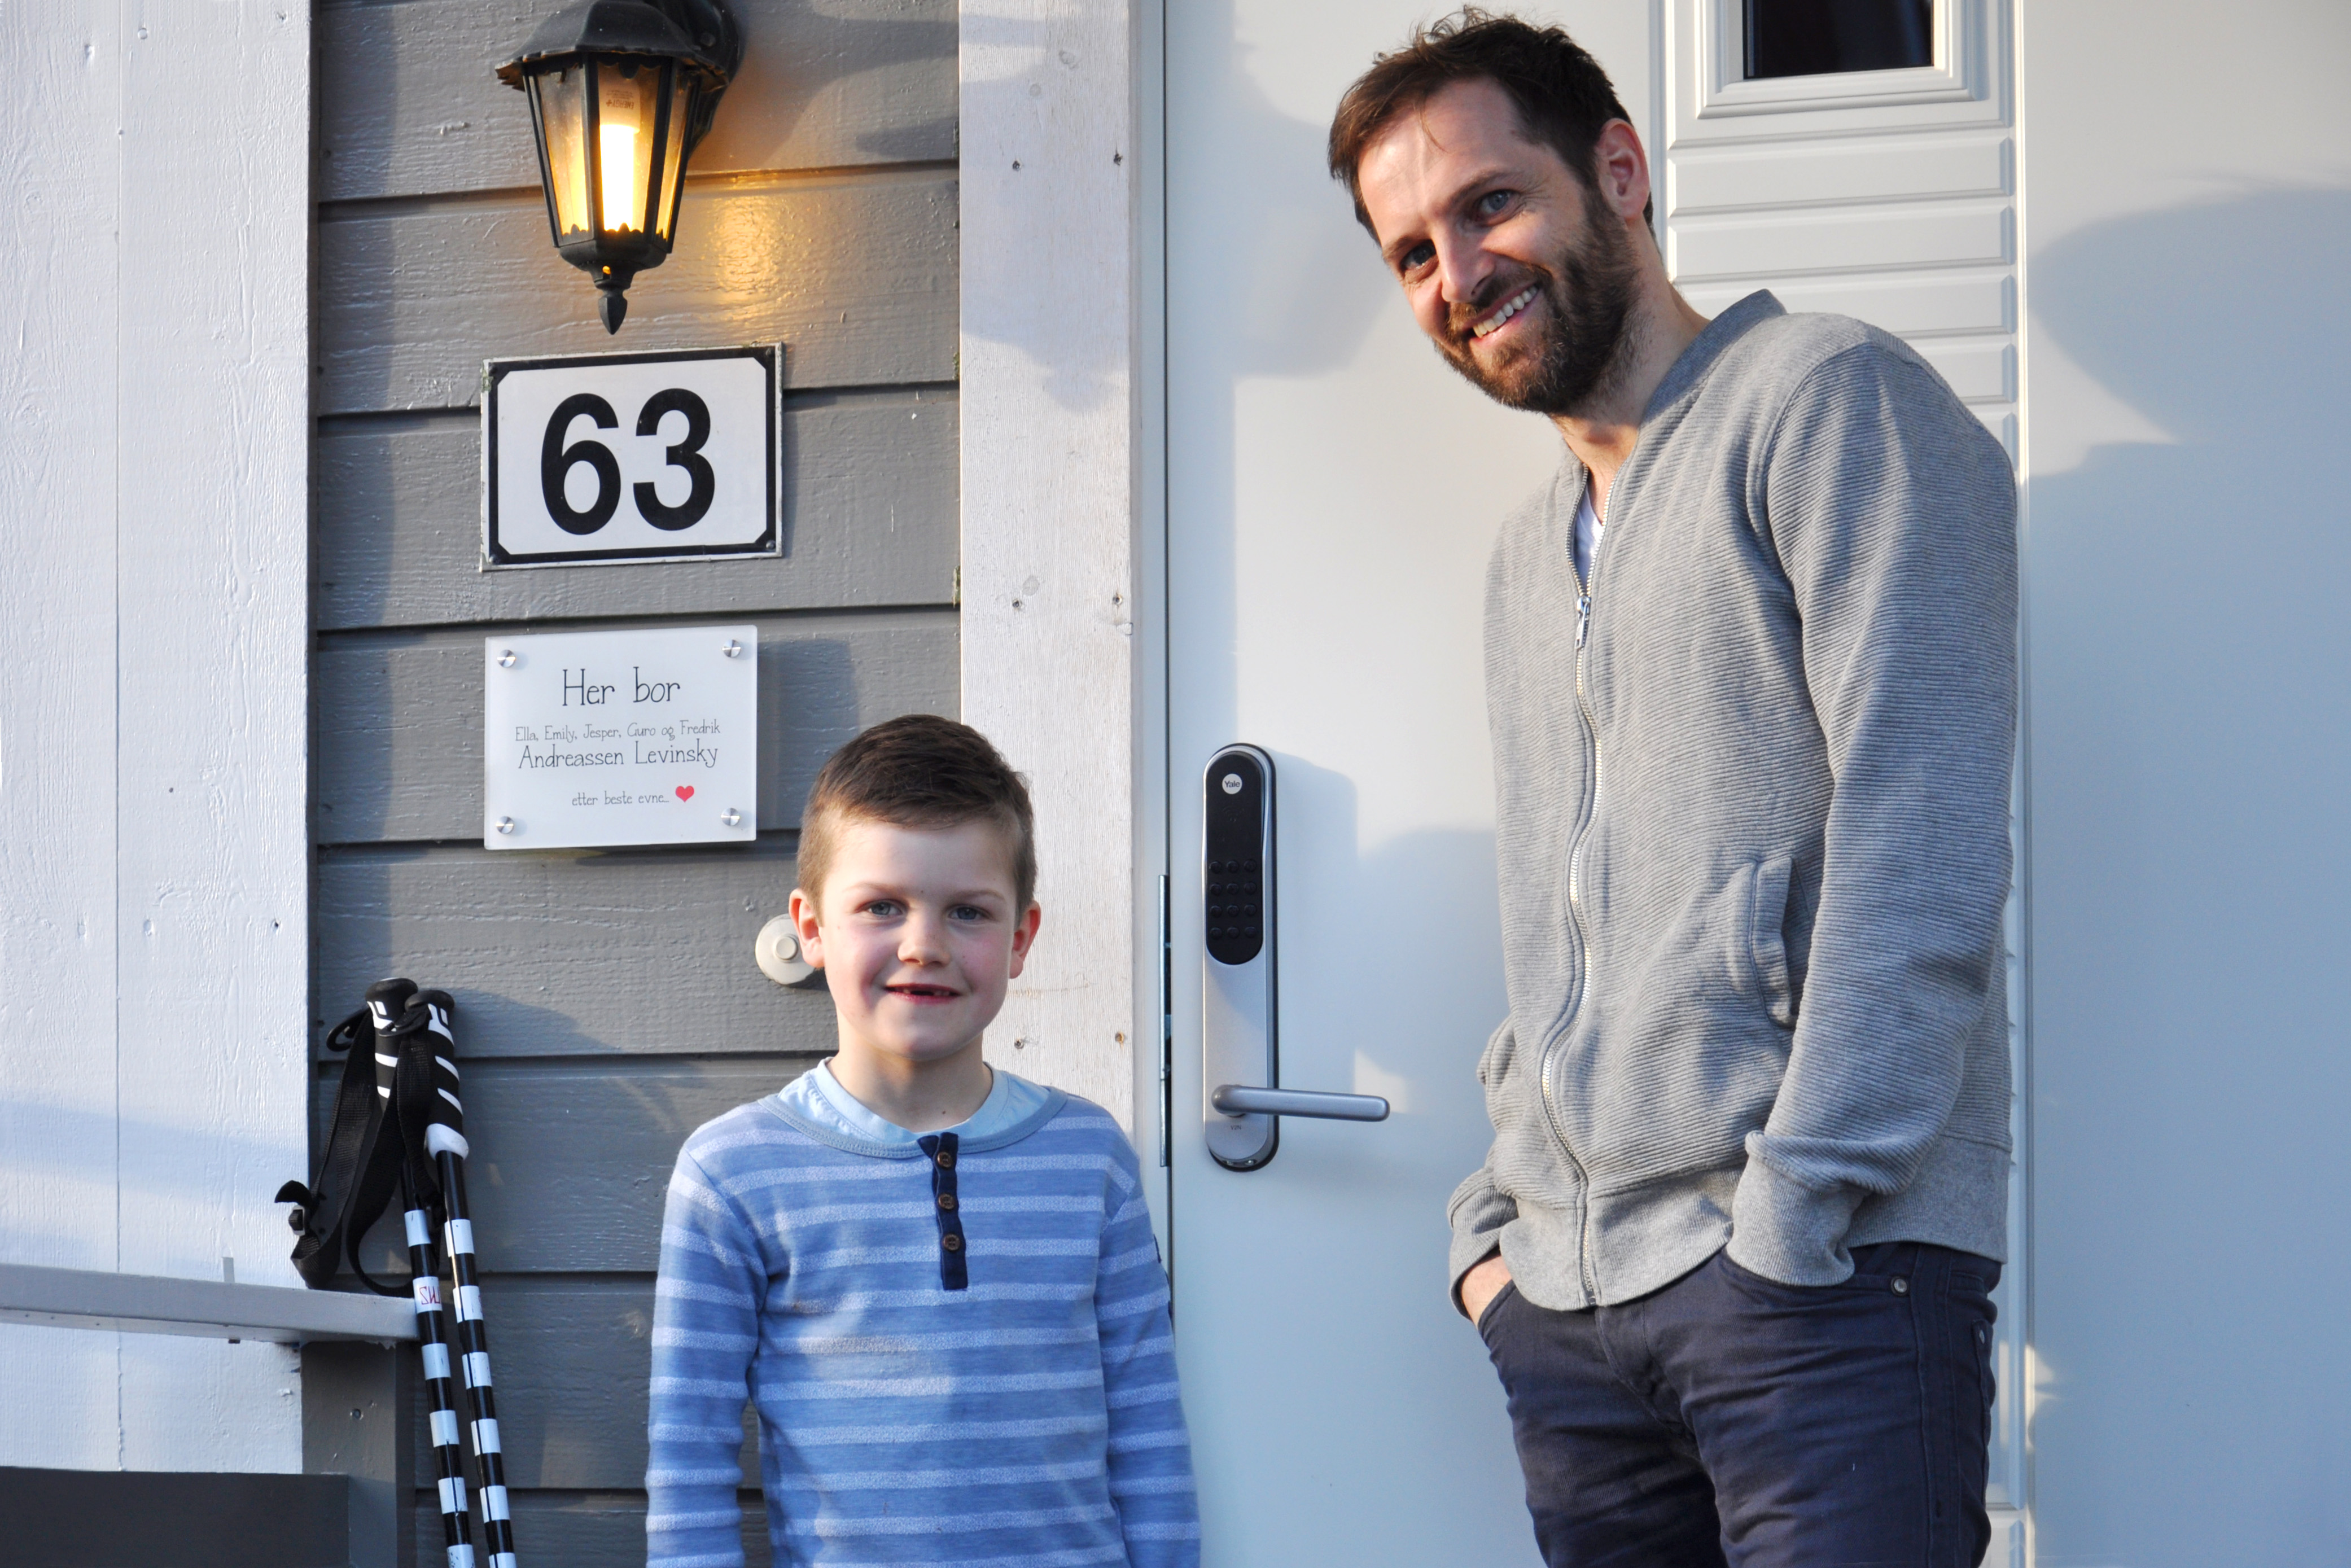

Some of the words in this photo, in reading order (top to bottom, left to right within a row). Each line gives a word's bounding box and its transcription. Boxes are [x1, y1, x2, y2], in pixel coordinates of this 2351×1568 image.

[540, 387, 716, 536] 63
[562, 668, 616, 707] Her
[632, 666, 681, 703] bor
[515, 726, 539, 742] Ella,
[545, 725, 577, 743] Emily,
[583, 724, 621, 742] Jesper,
[627, 722, 656, 737] Guro
[661, 726, 676, 741] og
[679, 719, 721, 735] Fredrik
[518, 743, 624, 769] Andreassen
[635, 738, 719, 768] Levinsky
[572, 792, 598, 806] etter
[604, 790, 633, 805] beste
